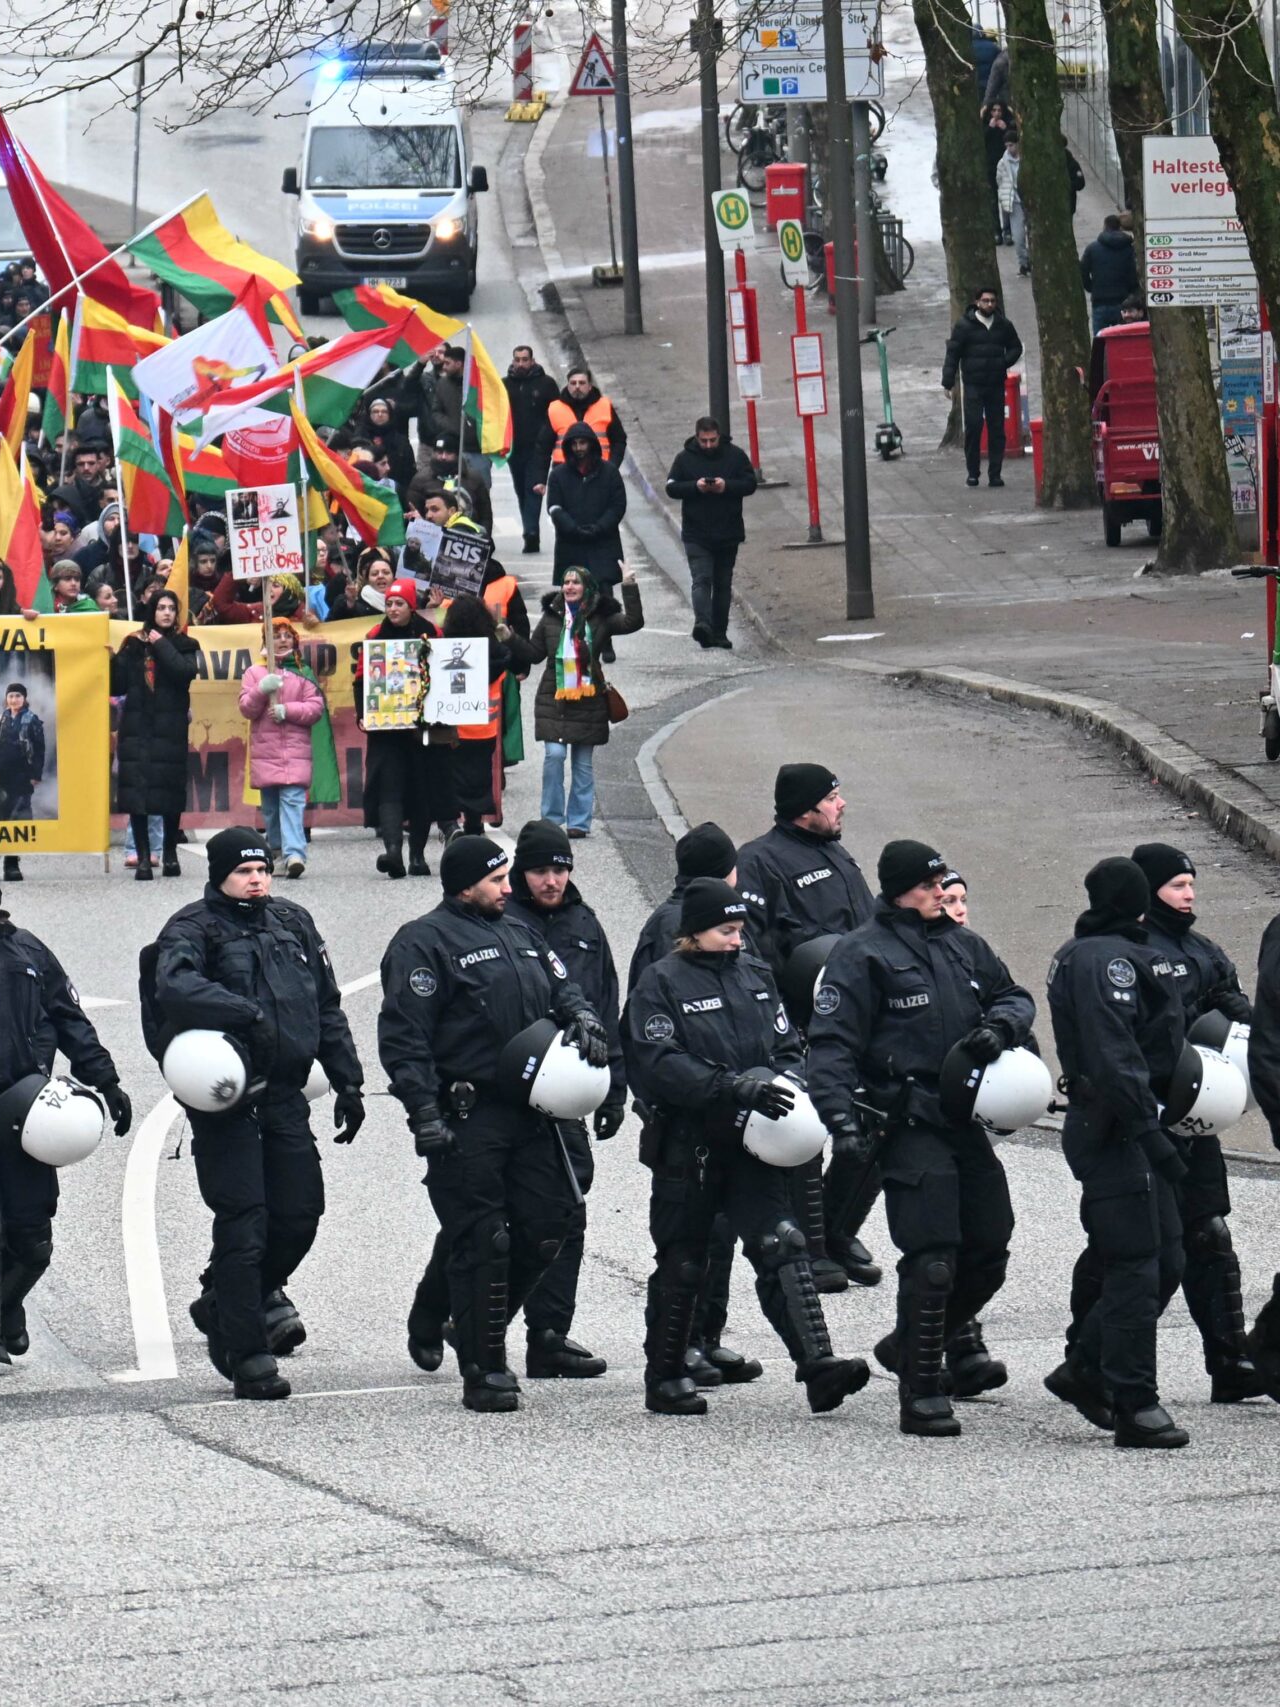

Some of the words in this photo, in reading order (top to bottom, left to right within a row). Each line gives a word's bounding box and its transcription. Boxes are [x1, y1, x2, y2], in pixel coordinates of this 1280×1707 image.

[761, 64, 805, 74] Phoenix
[1152, 159, 1226, 174] Halteste
[348, 200, 417, 211] POLIZEI
[1226, 219, 1244, 231] hv
[1152, 235, 1170, 245] X30
[1152, 250, 1170, 259] 543
[1152, 265, 1171, 274] 349
[1153, 280, 1171, 289] 152
[1153, 293, 1171, 302] 641
[237, 525, 287, 550] STOP
[443, 539, 482, 564] ISIS
[459, 947, 500, 969] POLIZEI
